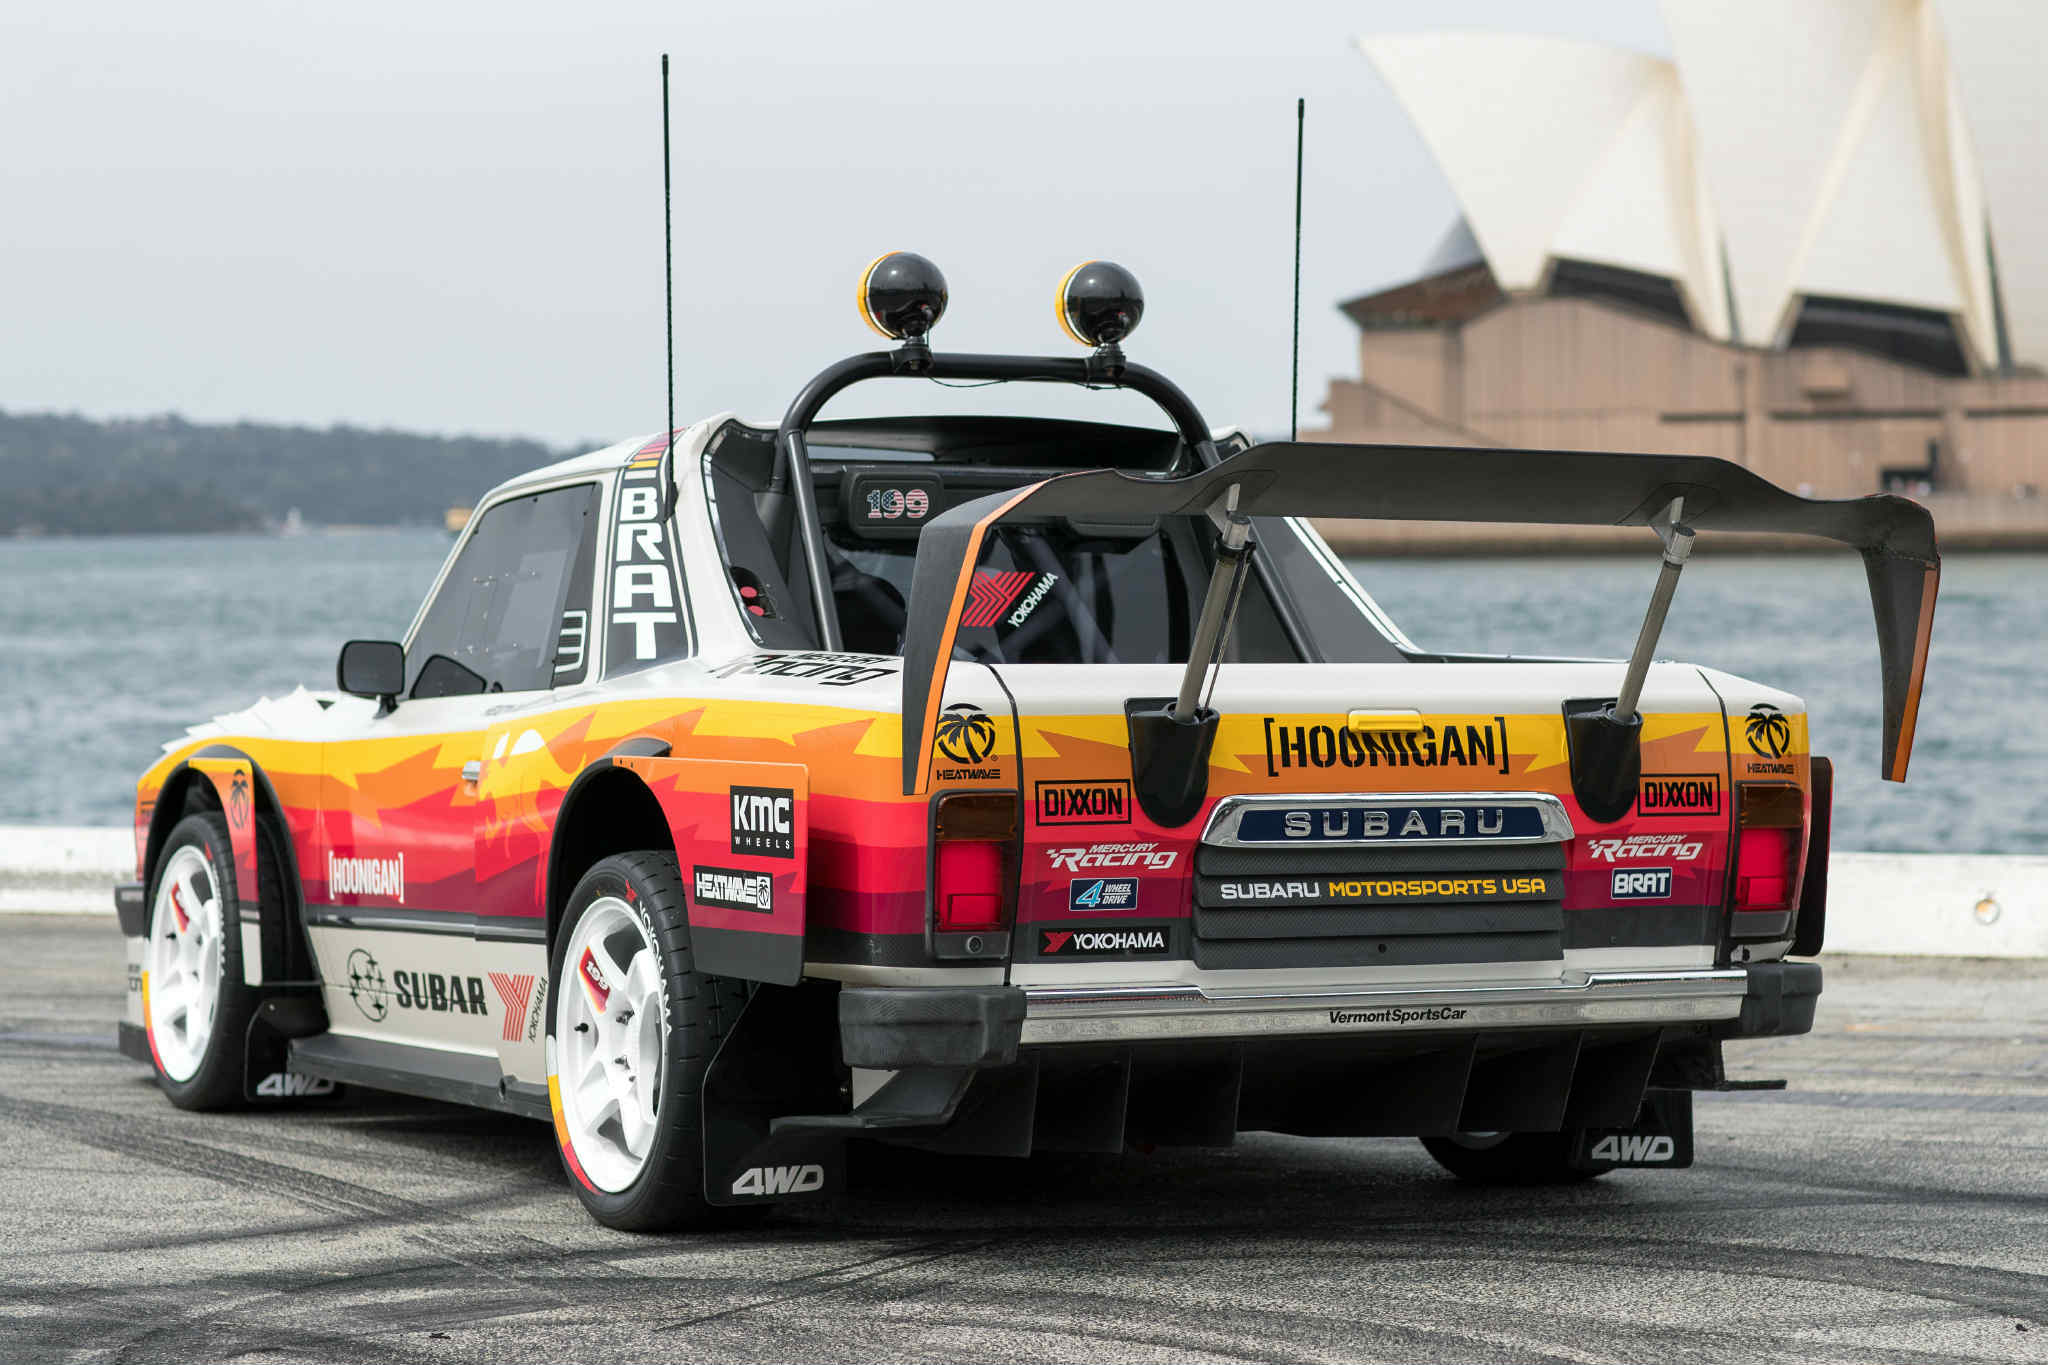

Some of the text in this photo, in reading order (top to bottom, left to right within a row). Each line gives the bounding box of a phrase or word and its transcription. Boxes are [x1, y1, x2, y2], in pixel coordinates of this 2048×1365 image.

[866, 488, 929, 519] 199
[613, 486, 677, 660] BRAT
[1007, 572, 1059, 627] YOKOHAMA
[936, 768, 1001, 780] HEATWAVE
[1747, 763, 1794, 774] HEATWAVE
[1044, 788, 1123, 817] DIXXON
[1644, 781, 1713, 808] DIXXON
[733, 794, 790, 834] KMC
[1284, 809, 1503, 837] SUBARU
[734, 836, 790, 850] WHEELS
[1089, 843, 1159, 854] MERCURY
[1587, 838, 1703, 863] Racing
[1625, 834, 1688, 844] MERCURY
[1046, 848, 1178, 872] Racing
[695, 872, 758, 905] HEATWAVE
[1075, 879, 1105, 908] 4
[1104, 883, 1132, 893] WHEEL
[1221, 878, 1547, 900] SUBARU MOTORSPORTS USA
[1614, 872, 1670, 894] BRAT
[1102, 895, 1129, 905] DRIVE
[1074, 932, 1164, 950] YOKOHAMA
[528, 975, 550, 1046] YOKOHAMA
[1329, 1007, 1467, 1024] VermontSportsCar
[1591, 1135, 1675, 1162] 4WD
[731, 1164, 825, 1196] 4WD
